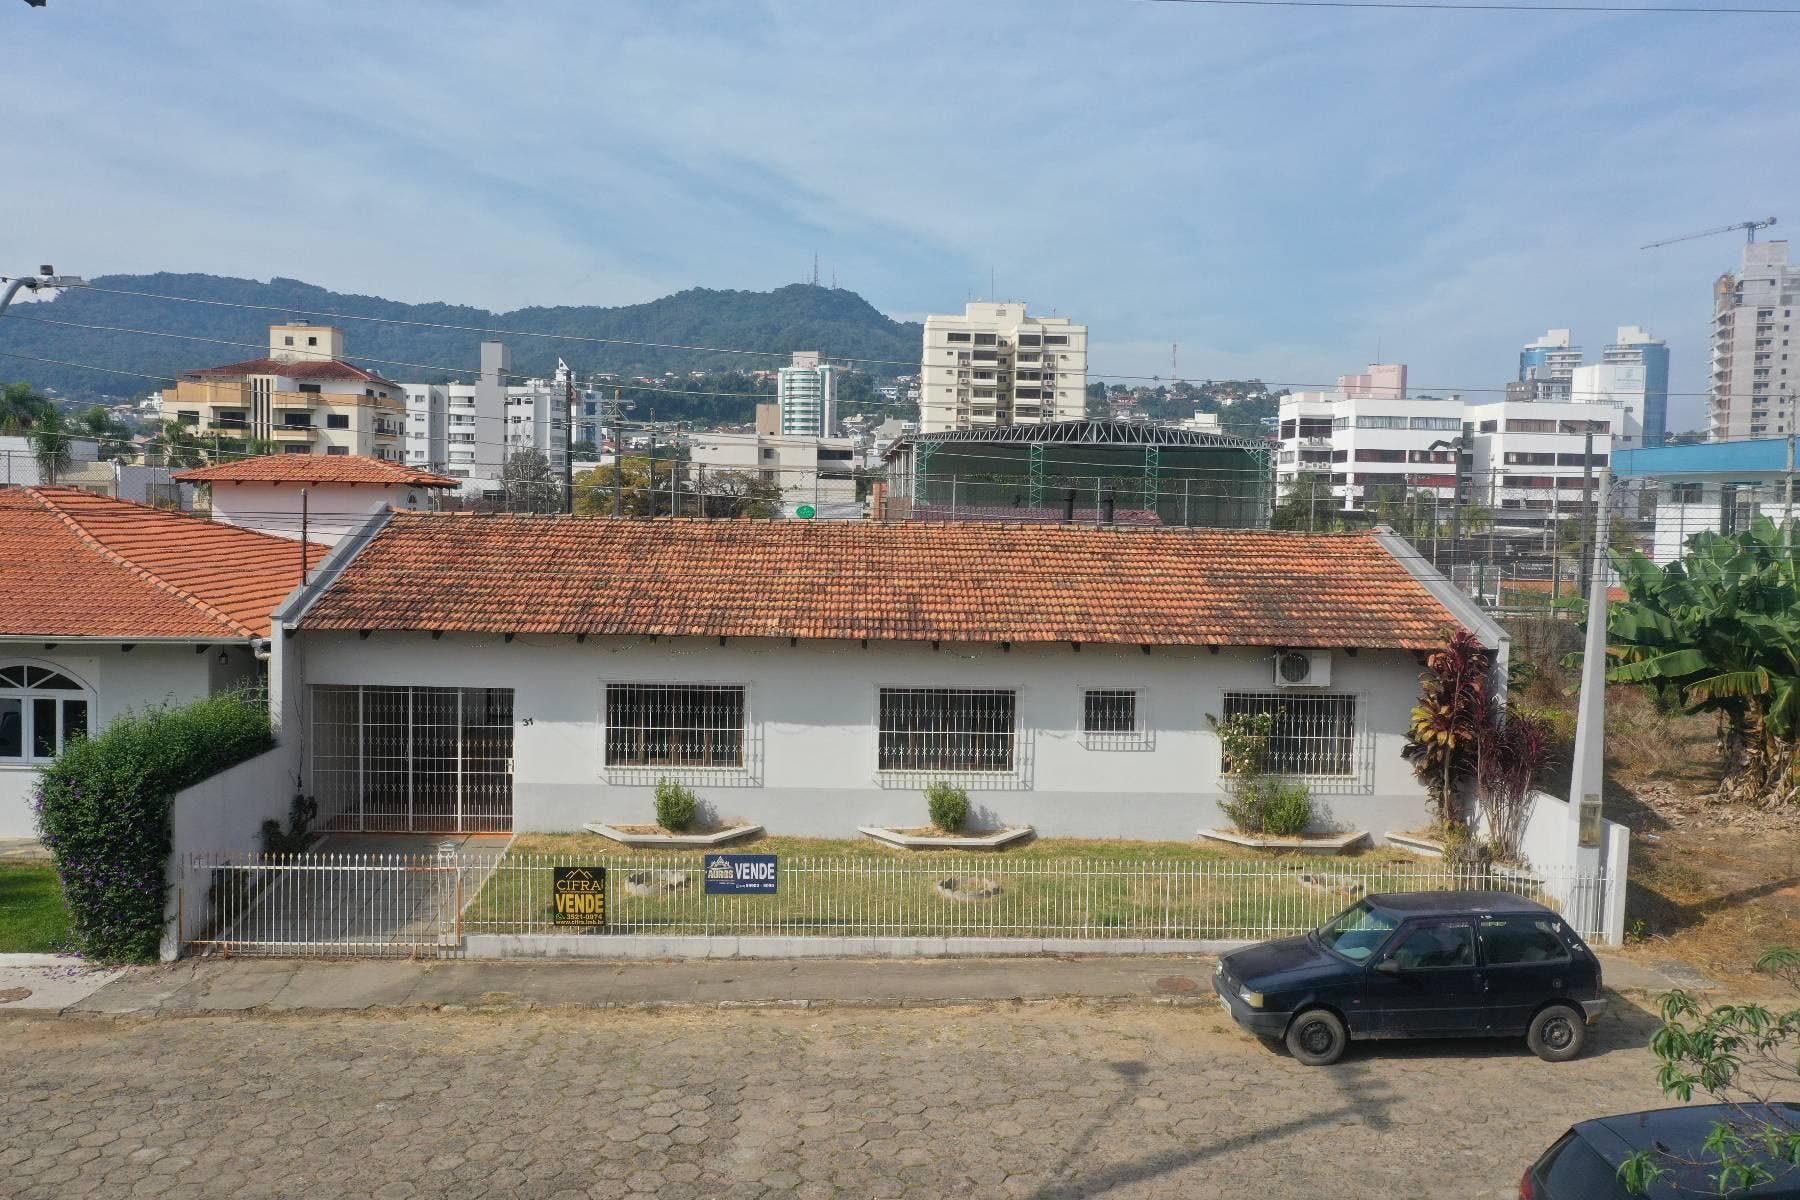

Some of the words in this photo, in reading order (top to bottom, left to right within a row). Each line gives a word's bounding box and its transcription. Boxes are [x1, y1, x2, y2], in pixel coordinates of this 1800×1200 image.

[707, 870, 734, 879] AUROS
[735, 863, 775, 880] VENDE
[556, 880, 601, 891] CIFRA
[555, 893, 604, 913] VENDE
